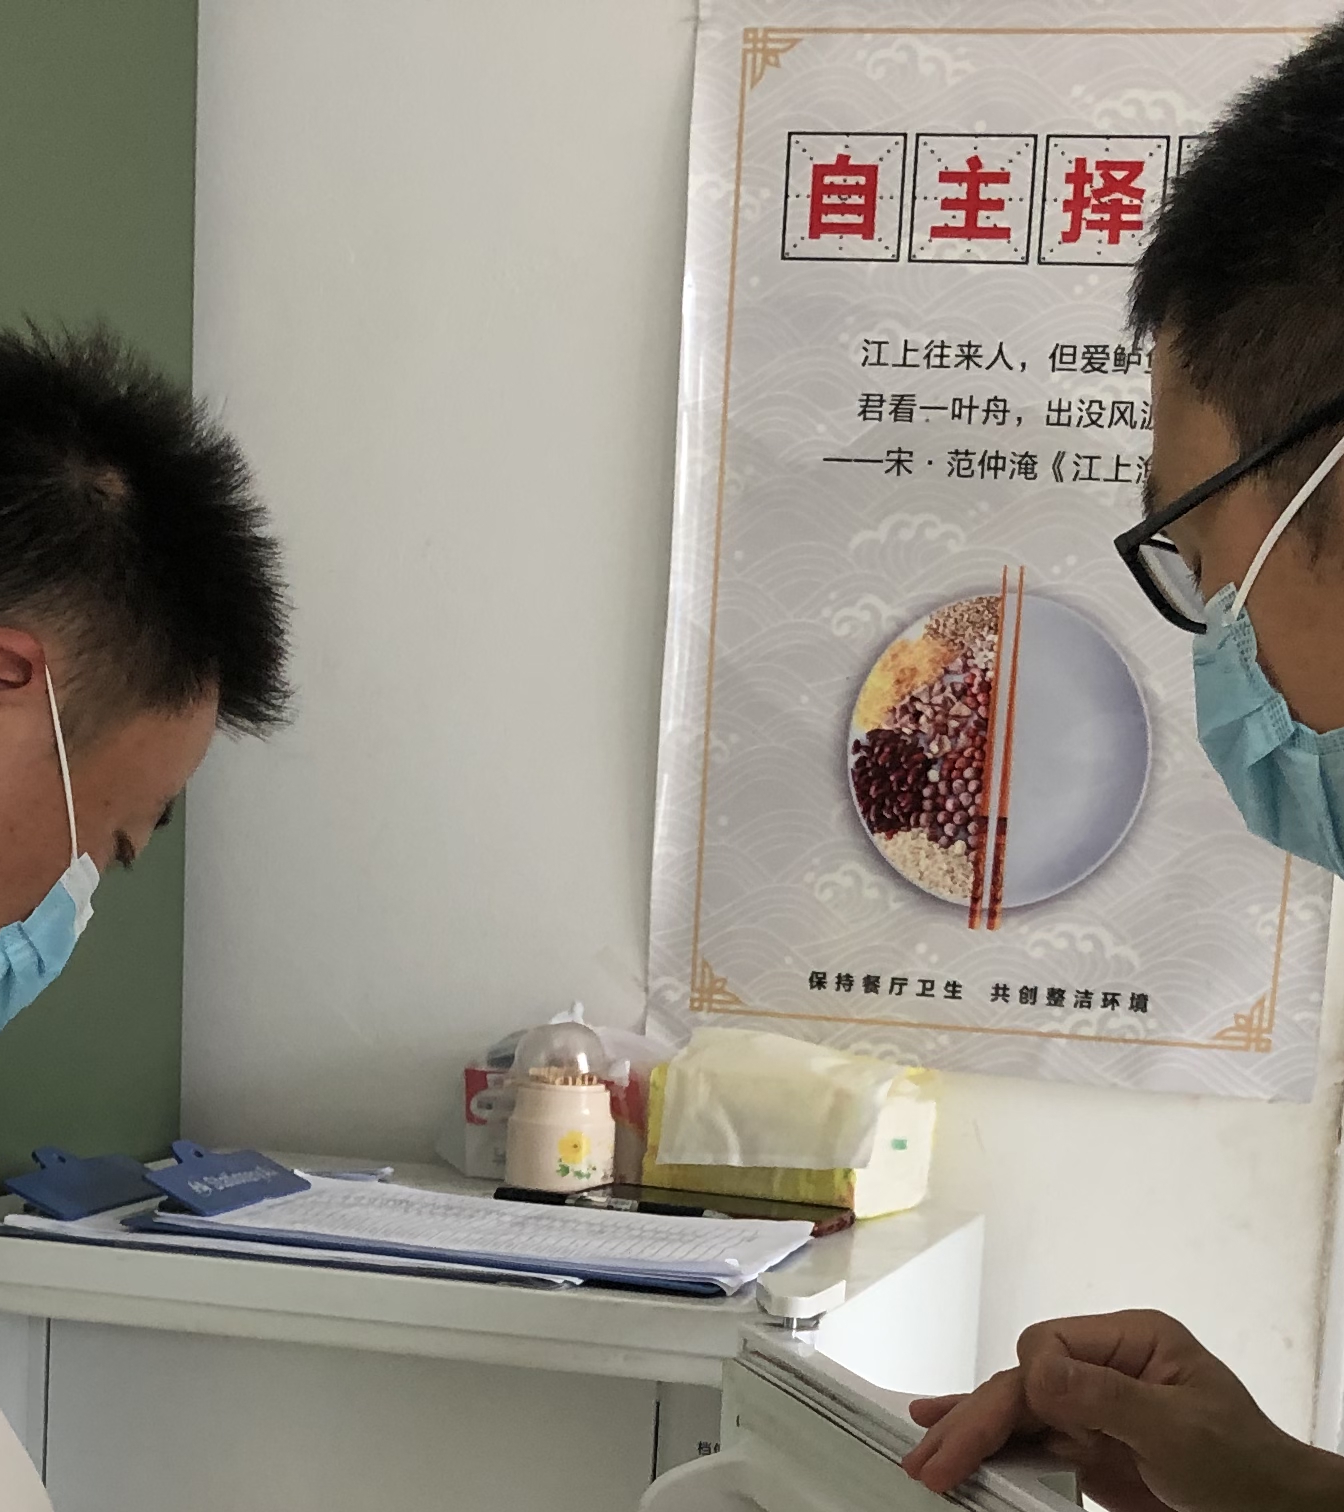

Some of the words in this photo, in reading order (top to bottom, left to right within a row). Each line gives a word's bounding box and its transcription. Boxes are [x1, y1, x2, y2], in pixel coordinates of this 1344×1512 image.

[807, 153, 1146, 245] 自主择
[860, 337, 1153, 375] 江上往来人，但爱鲈
[808, 970, 963, 1000] 保持餐厅卫生
[989, 982, 1149, 1014] 共创整洁环境
